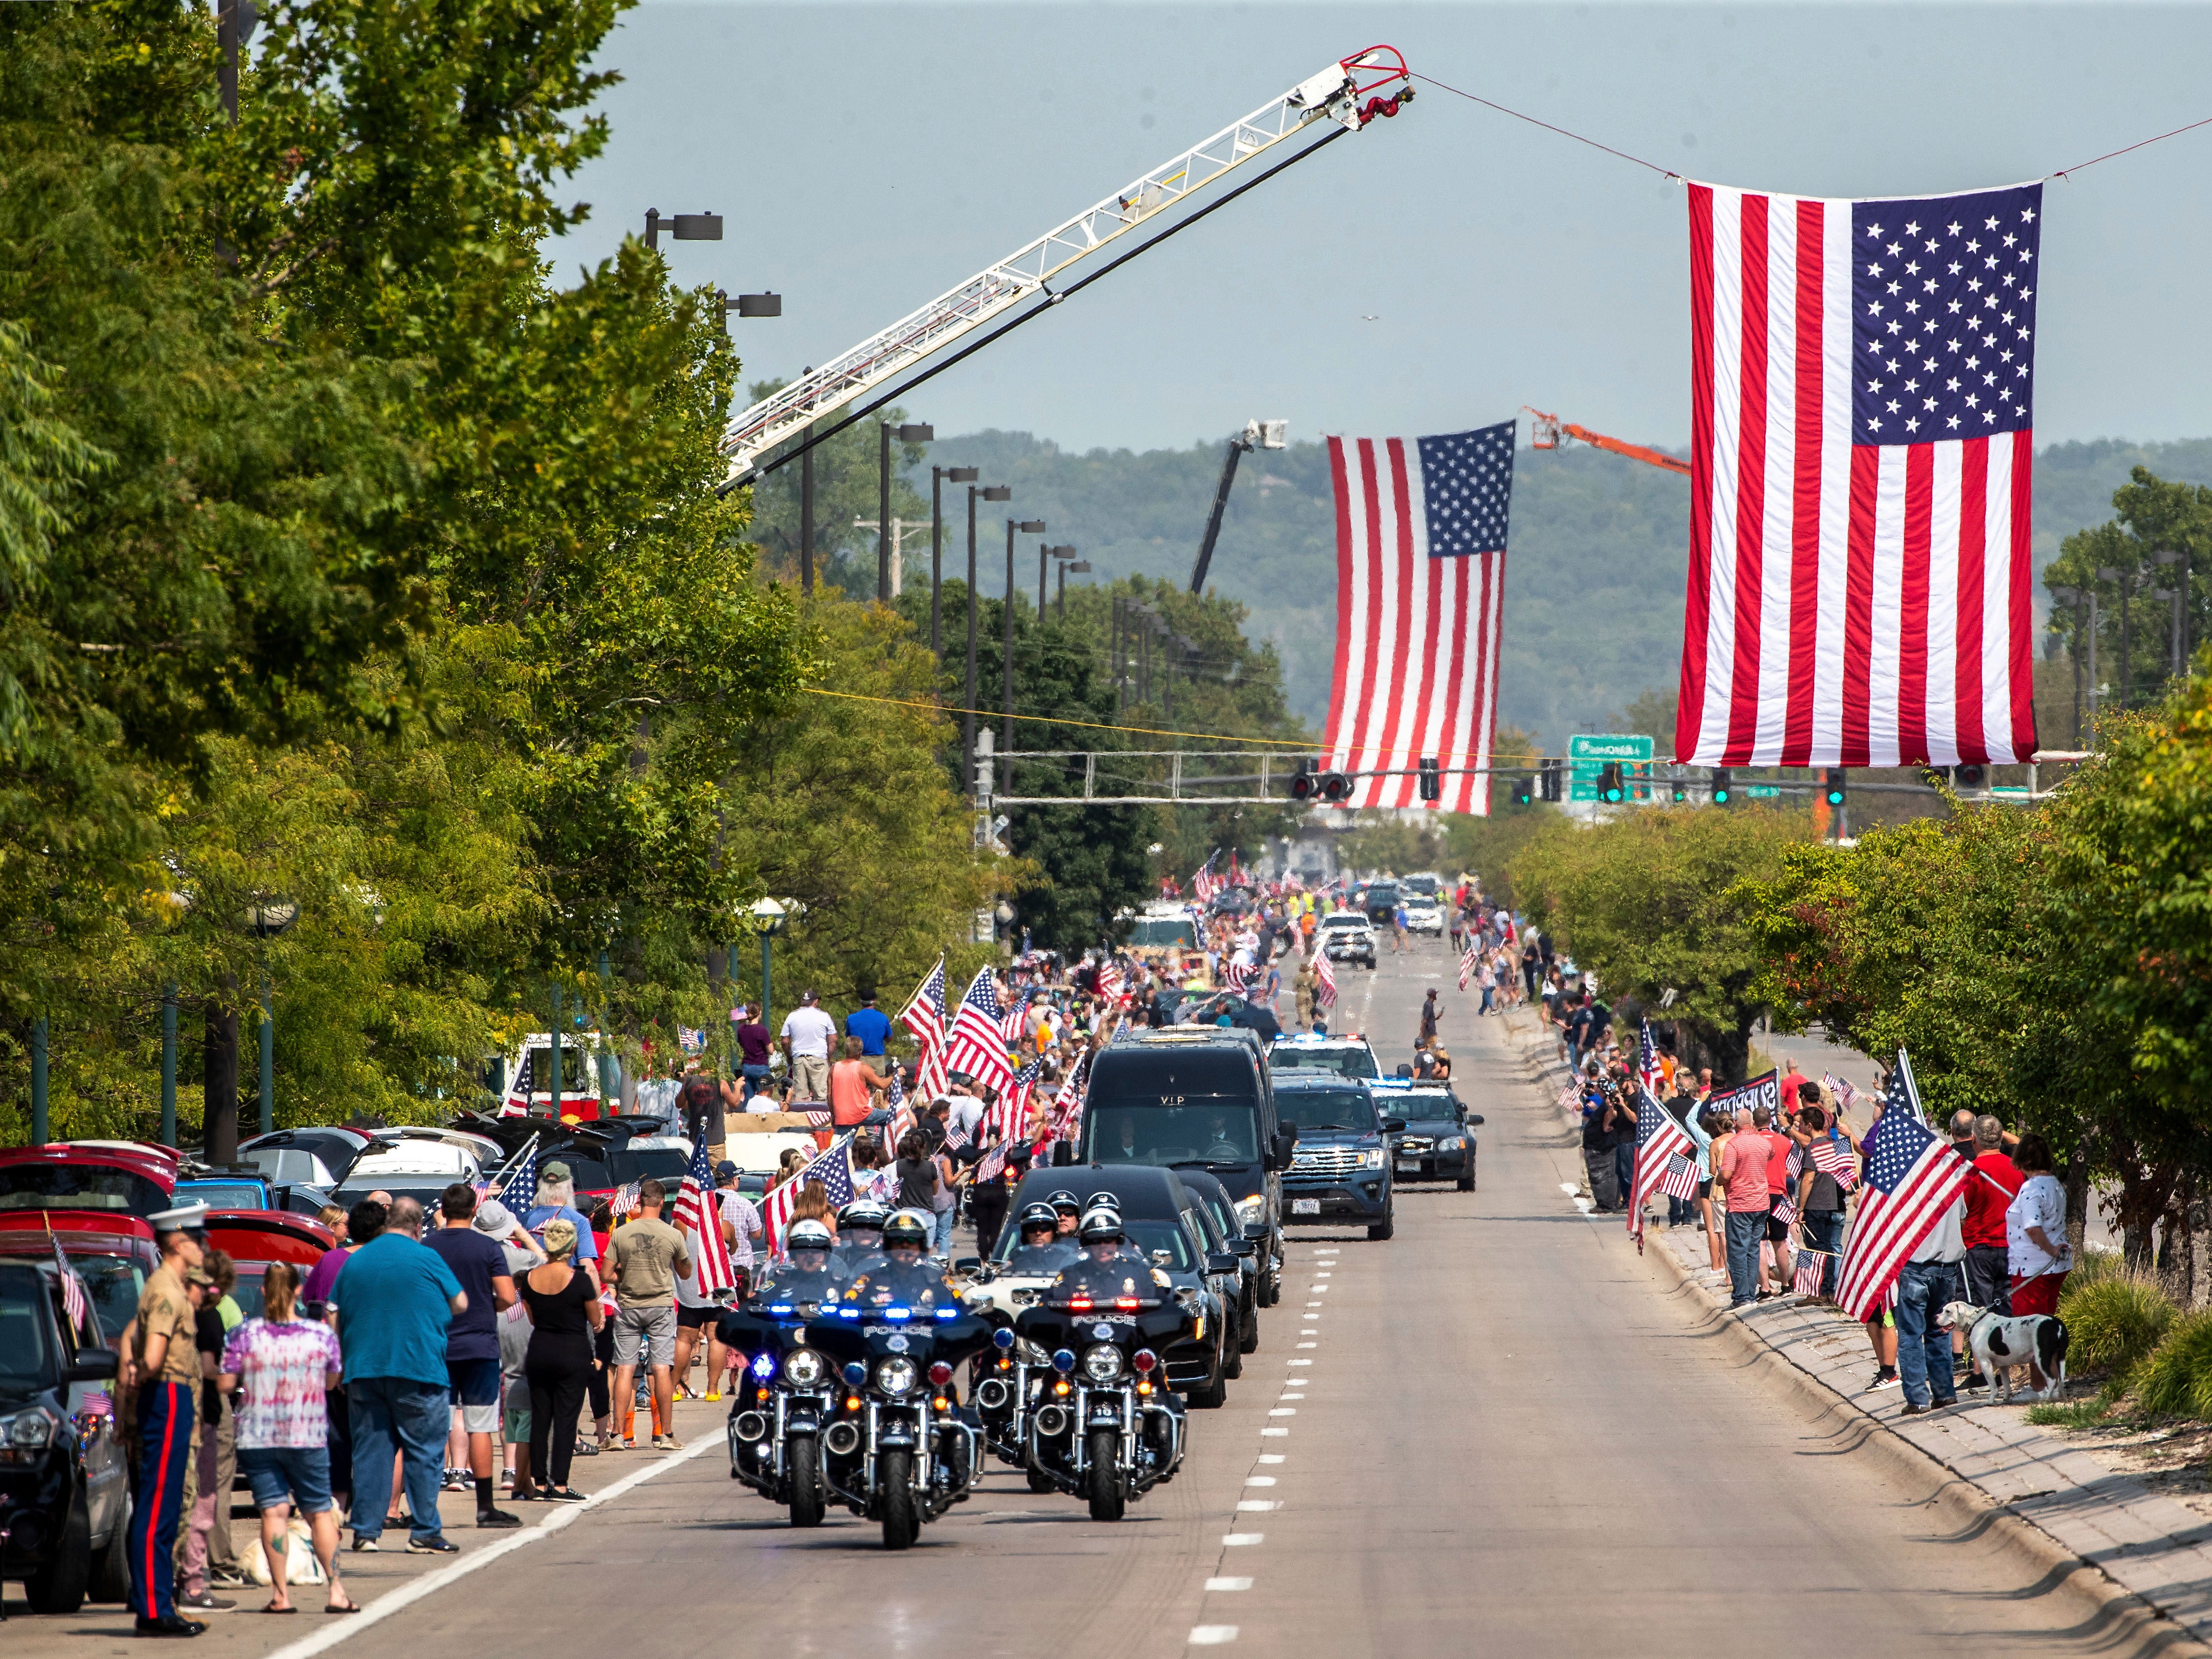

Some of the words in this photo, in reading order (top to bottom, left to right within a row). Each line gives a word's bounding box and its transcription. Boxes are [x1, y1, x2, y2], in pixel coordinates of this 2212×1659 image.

[1161, 1096, 1184, 1105] VIP
[1071, 1314, 1136, 1327] POLICE
[863, 1325, 932, 1339] POLICE
[1095, 1408, 1112, 1417] 10
